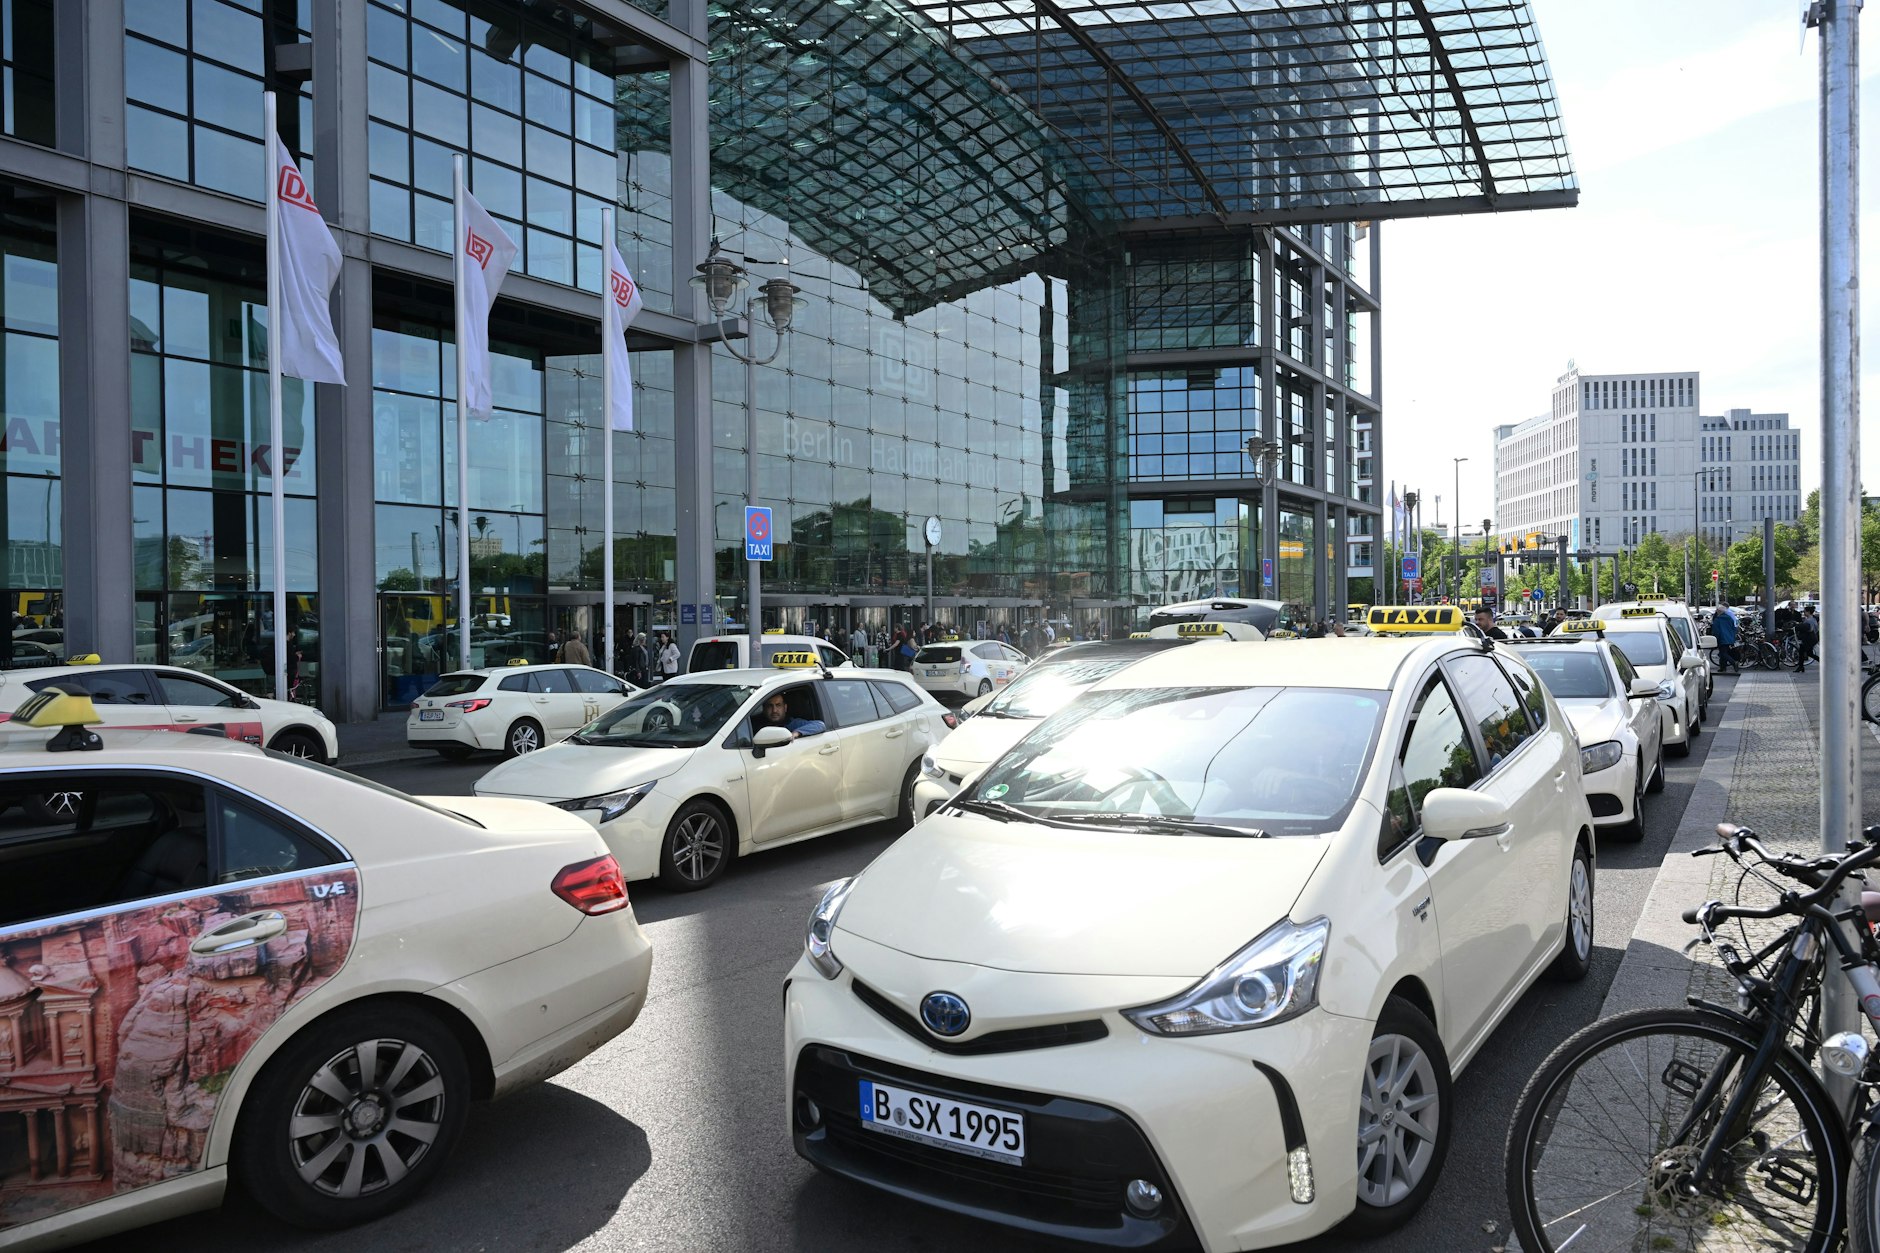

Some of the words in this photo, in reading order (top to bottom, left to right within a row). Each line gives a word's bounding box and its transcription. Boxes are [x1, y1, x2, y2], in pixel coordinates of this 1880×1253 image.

[782, 418, 854, 464] Berlin
[871, 436, 1000, 487] Hauptbahnhof
[748, 543, 770, 556] TAXI
[1381, 609, 1442, 624] TAXI
[1626, 607, 1650, 615] TAXI
[1183, 619, 1213, 632] TAXI
[1569, 621, 1598, 630] TAXI
[777, 654, 804, 664] TAXI
[864, 1104, 870, 1114] D
[875, 1088, 891, 1121] B
[909, 1097, 942, 1135] SX
[949, 1106, 1020, 1151] 1995
